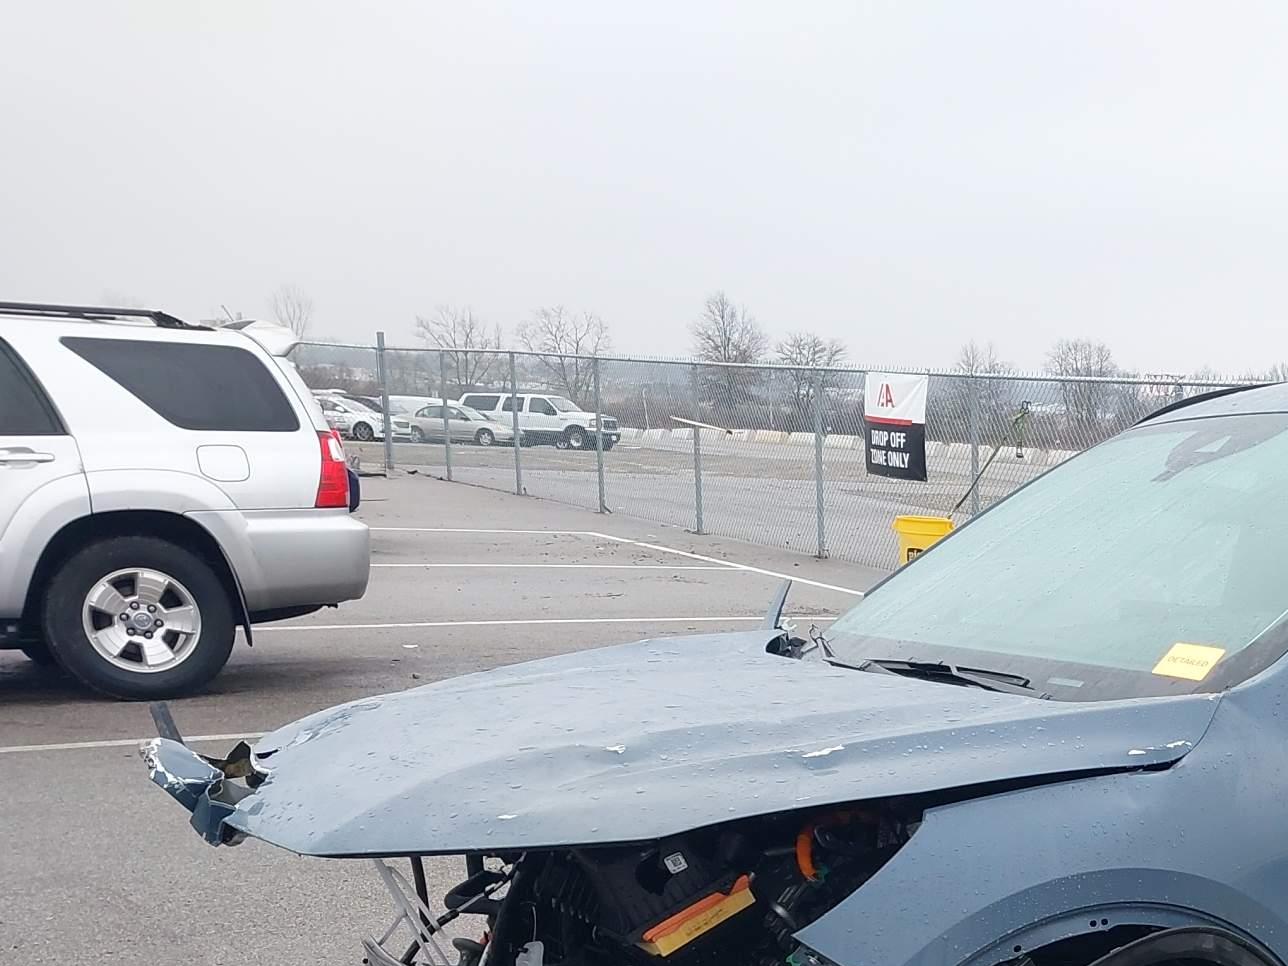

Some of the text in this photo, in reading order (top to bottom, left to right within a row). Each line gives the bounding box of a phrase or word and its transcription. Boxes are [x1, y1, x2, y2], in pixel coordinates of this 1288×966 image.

[871, 429, 906, 448] DROP OFF
[870, 448, 910, 469] ZONE ONLY
